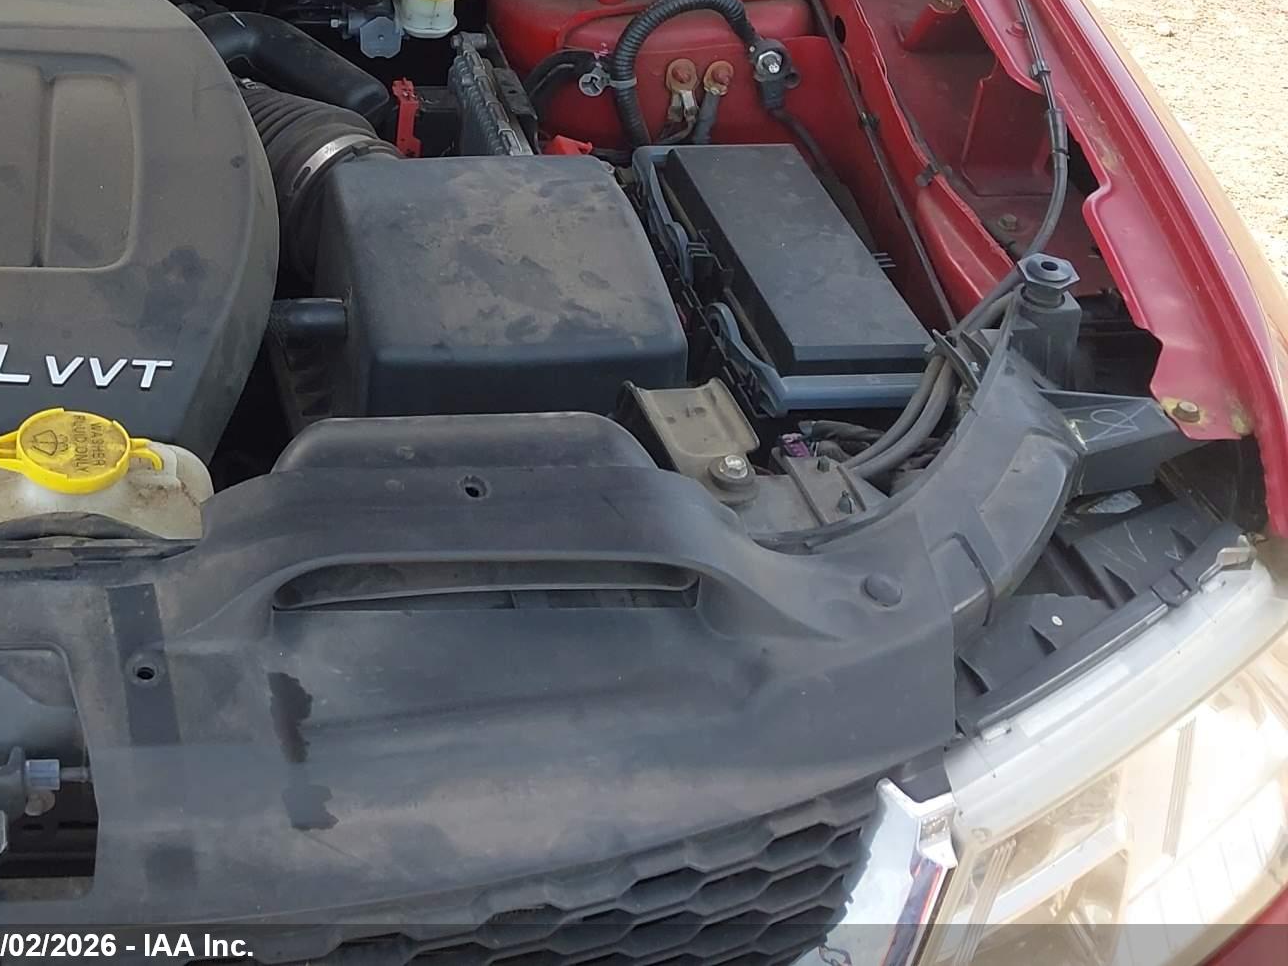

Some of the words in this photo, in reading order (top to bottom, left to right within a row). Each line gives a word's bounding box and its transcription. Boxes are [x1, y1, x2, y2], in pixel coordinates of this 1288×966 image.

[45, 355, 174, 388] VVT
[73, 415, 87, 443] FLUID
[91, 422, 106, 466] WASHER
[74, 446, 88, 473] ONLY
